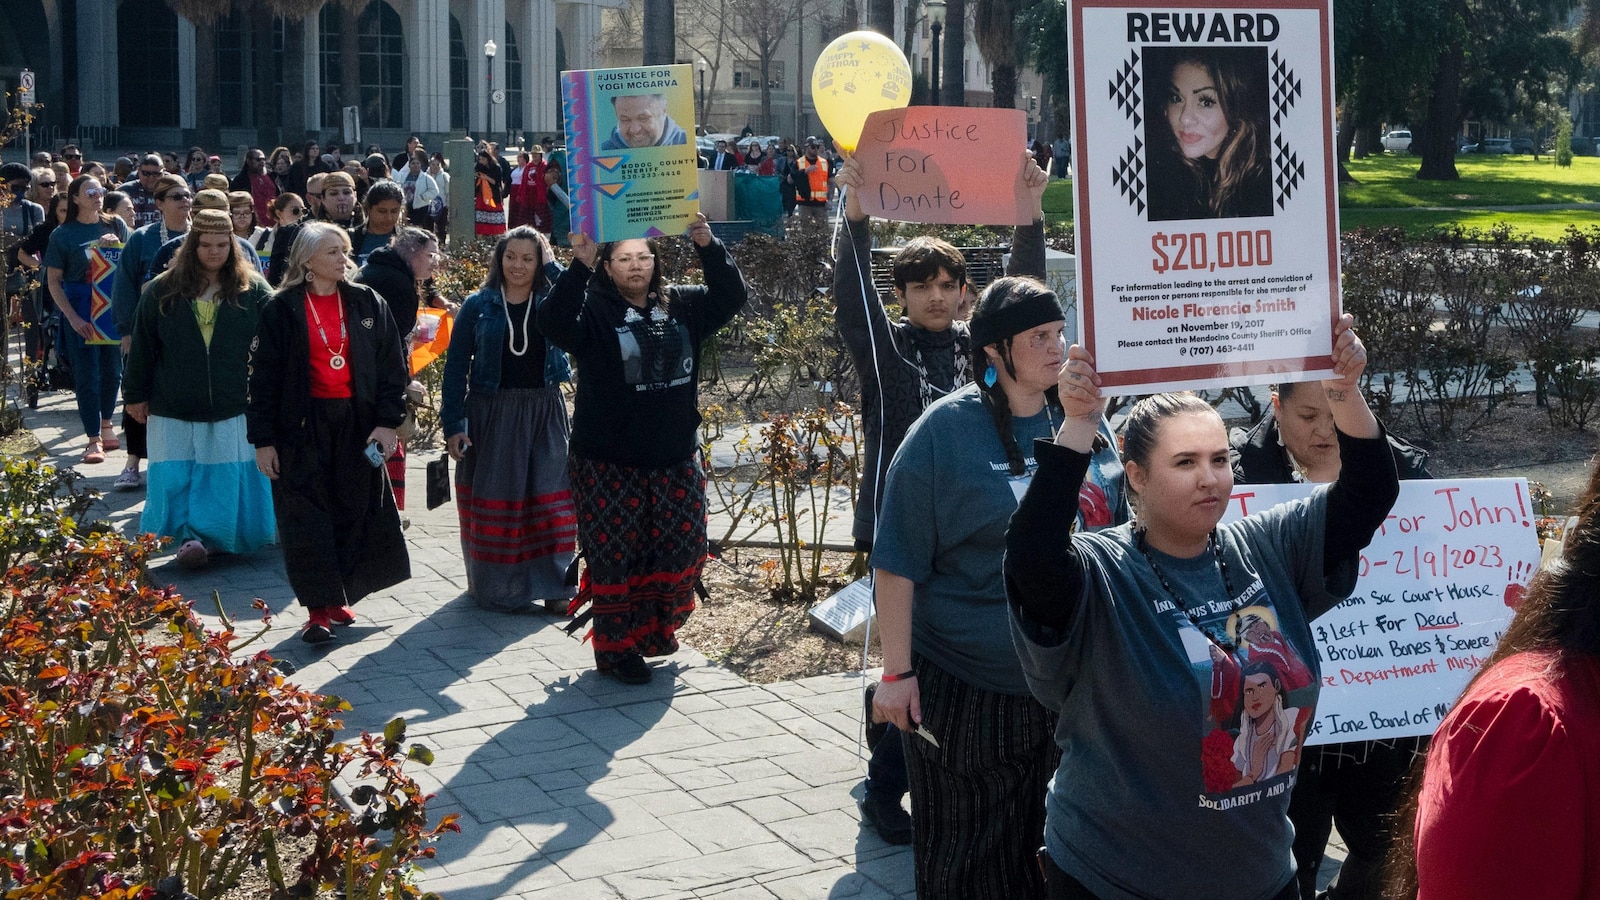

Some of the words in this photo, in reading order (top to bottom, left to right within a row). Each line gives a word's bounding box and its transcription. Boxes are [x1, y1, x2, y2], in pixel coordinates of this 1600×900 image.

[1126, 12, 1280, 43] REWARD
[597, 71, 647, 81] #JUSTICE
[650, 70, 671, 78] FOR
[598, 82, 624, 91] YOGI
[627, 79, 678, 89] MCGARVA
[875, 118, 980, 143] Justice
[621, 167, 658, 175] SHERIFF
[879, 182, 965, 212] Dante
[1151, 229, 1273, 274] $20,000
[1111, 284, 1124, 292] For
[1126, 282, 1172, 292] information
[1174, 280, 1203, 289] leading
[1213, 278, 1226, 286] the
[1228, 277, 1250, 285] arrest
[1251, 276, 1266, 284] and
[1267, 275, 1304, 283] conviction
[1134, 294, 1160, 303] person
[1171, 292, 1200, 300] persons
[1201, 288, 1243, 298] responsible
[1244, 287, 1255, 295] for
[1256, 286, 1269, 294] the
[1270, 285, 1297, 293] murder
[1132, 305, 1179, 321] Nicole
[1183, 301, 1251, 318] Florencia
[1255, 297, 1296, 313] Smith
[1180, 321, 1229, 332] November
[1230, 321, 1243, 330] 19,
[1244, 319, 1265, 328] 2017
[1117, 340, 1143, 348] Please
[1145, 338, 1173, 346] contact
[1175, 336, 1188, 344] the
[1189, 333, 1230, 343] Mendocino
[1231, 332, 1258, 340] County
[1259, 328, 1288, 338] Sheriff's
[1289, 328, 1312, 336] Office
[1179, 347, 1187, 356] @
[1189, 345, 1214, 357] (707)
[1216, 343, 1255, 353] 463-4411
[1434, 482, 1531, 532] John!
[1370, 590, 1396, 606] Sac
[1402, 587, 1444, 603] Court
[1330, 620, 1369, 641] Left
[1376, 615, 1407, 633] For
[1327, 644, 1384, 662] Broken
[1389, 640, 1432, 657] Bones
[1446, 635, 1493, 651] Severe
[1340, 659, 1439, 685] Department
[1369, 710, 1411, 730] Band
[1413, 707, 1432, 724] of
